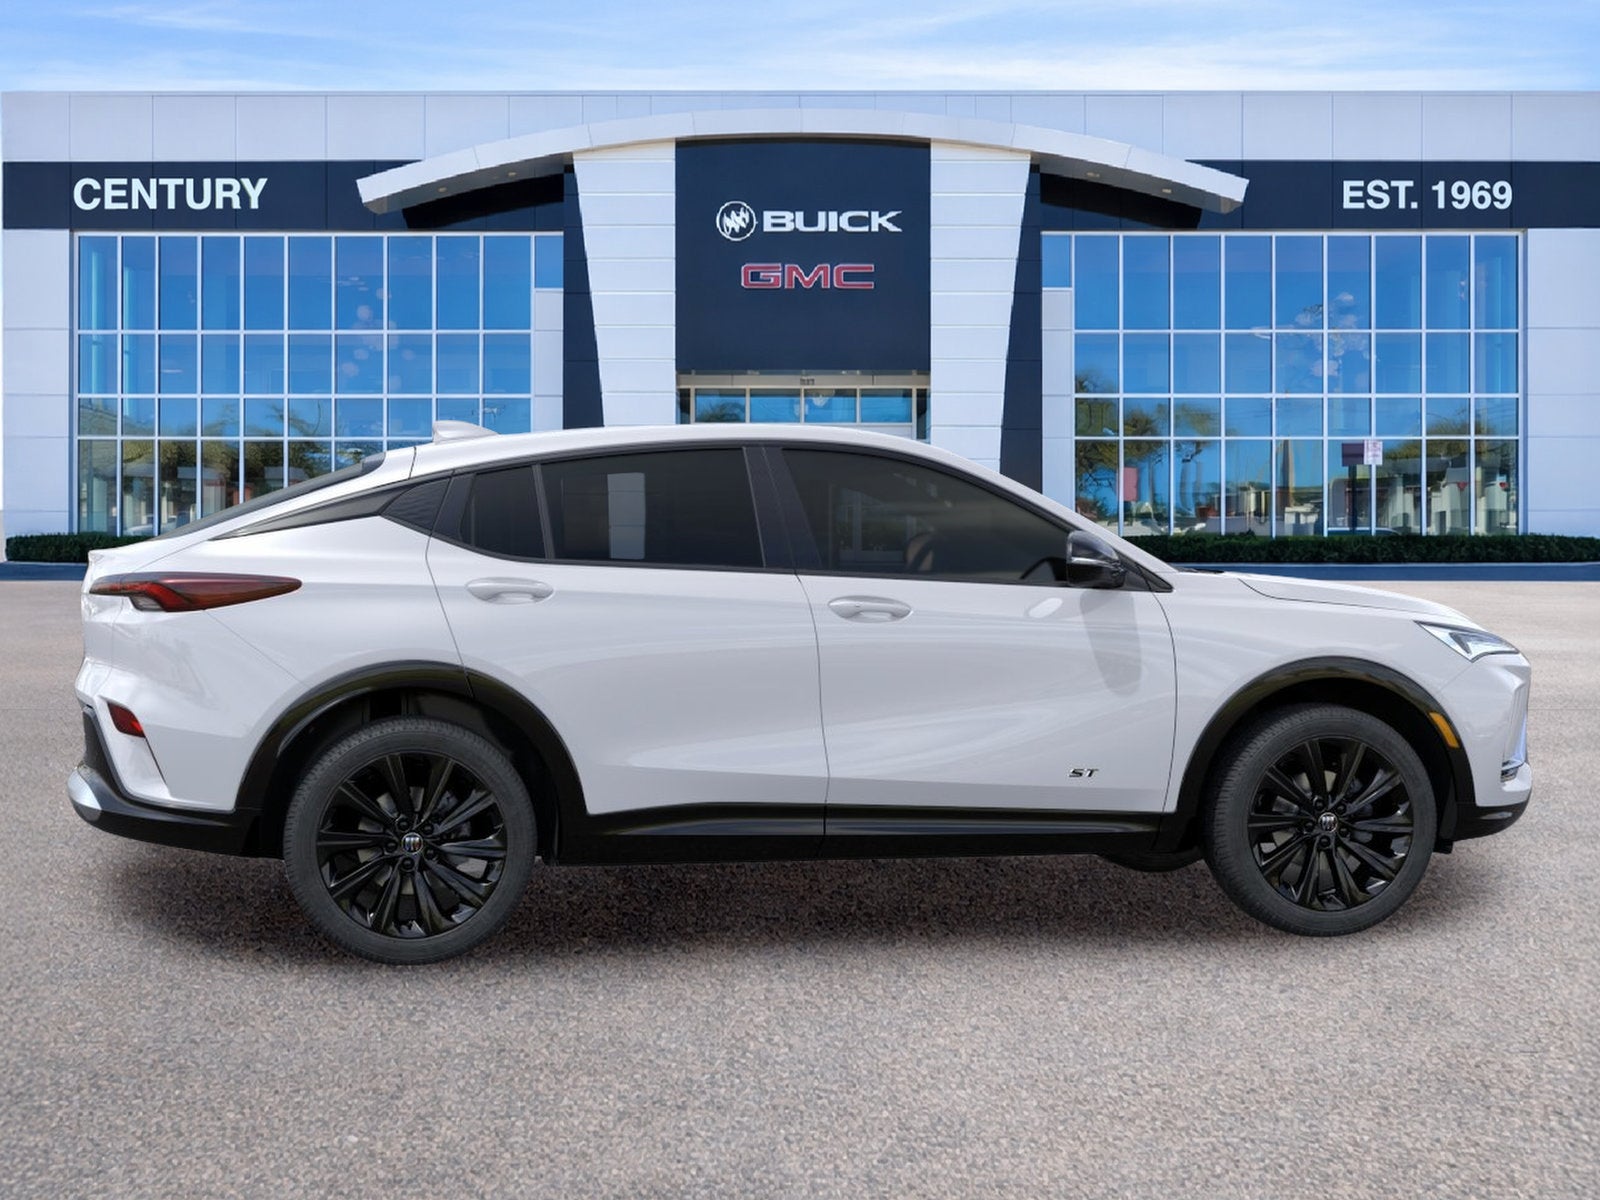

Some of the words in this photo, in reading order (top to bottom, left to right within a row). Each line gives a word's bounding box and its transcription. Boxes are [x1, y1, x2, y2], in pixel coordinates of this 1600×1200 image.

[73, 177, 268, 210] CENTURY
[1342, 179, 1418, 210] EST.
[1431, 180, 1513, 210] 1969
[762, 210, 903, 232] BUICK
[740, 263, 875, 289] GMC
[1069, 768, 1099, 778] ST
